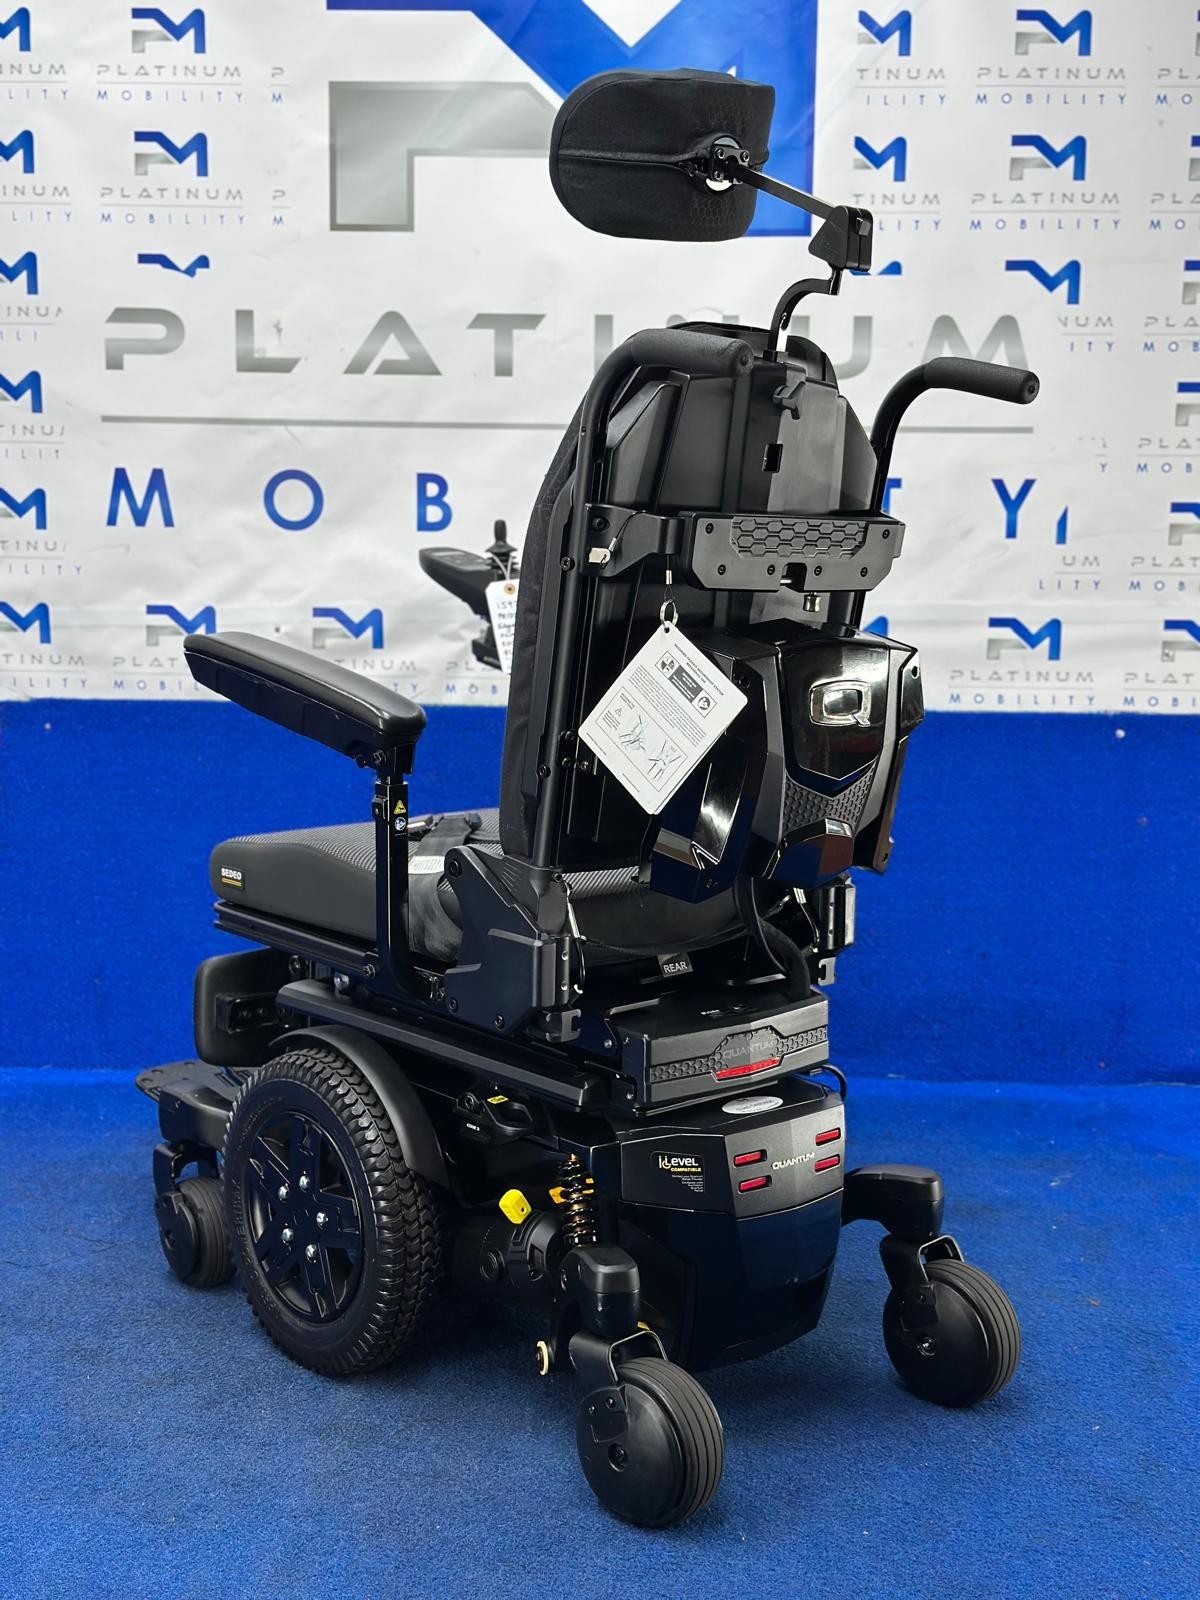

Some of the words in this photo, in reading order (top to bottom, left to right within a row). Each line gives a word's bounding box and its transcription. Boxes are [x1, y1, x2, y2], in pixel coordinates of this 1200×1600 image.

[97, 65, 242, 78] PLATINUM
[977, 67, 1126, 79] PLATINUM
[96, 89, 243, 102] MOBILITY
[976, 93, 1126, 105] MOBILITY
[100, 187, 243, 201] PLATINUM
[971, 192, 1119, 204] PLATINUM
[101, 213, 245, 225] MOBILITY
[970, 218, 1120, 230] MOBILITY
[950, 671, 1094, 683] PLATINUM
[950, 694, 1095, 706] MOBILITY
[221, 868, 242, 880] SEDEO
[663, 961, 688, 974] REAR
[723, 1038, 774, 1060] QUANTUM
[772, 1152, 816, 1171] QUANTUM
